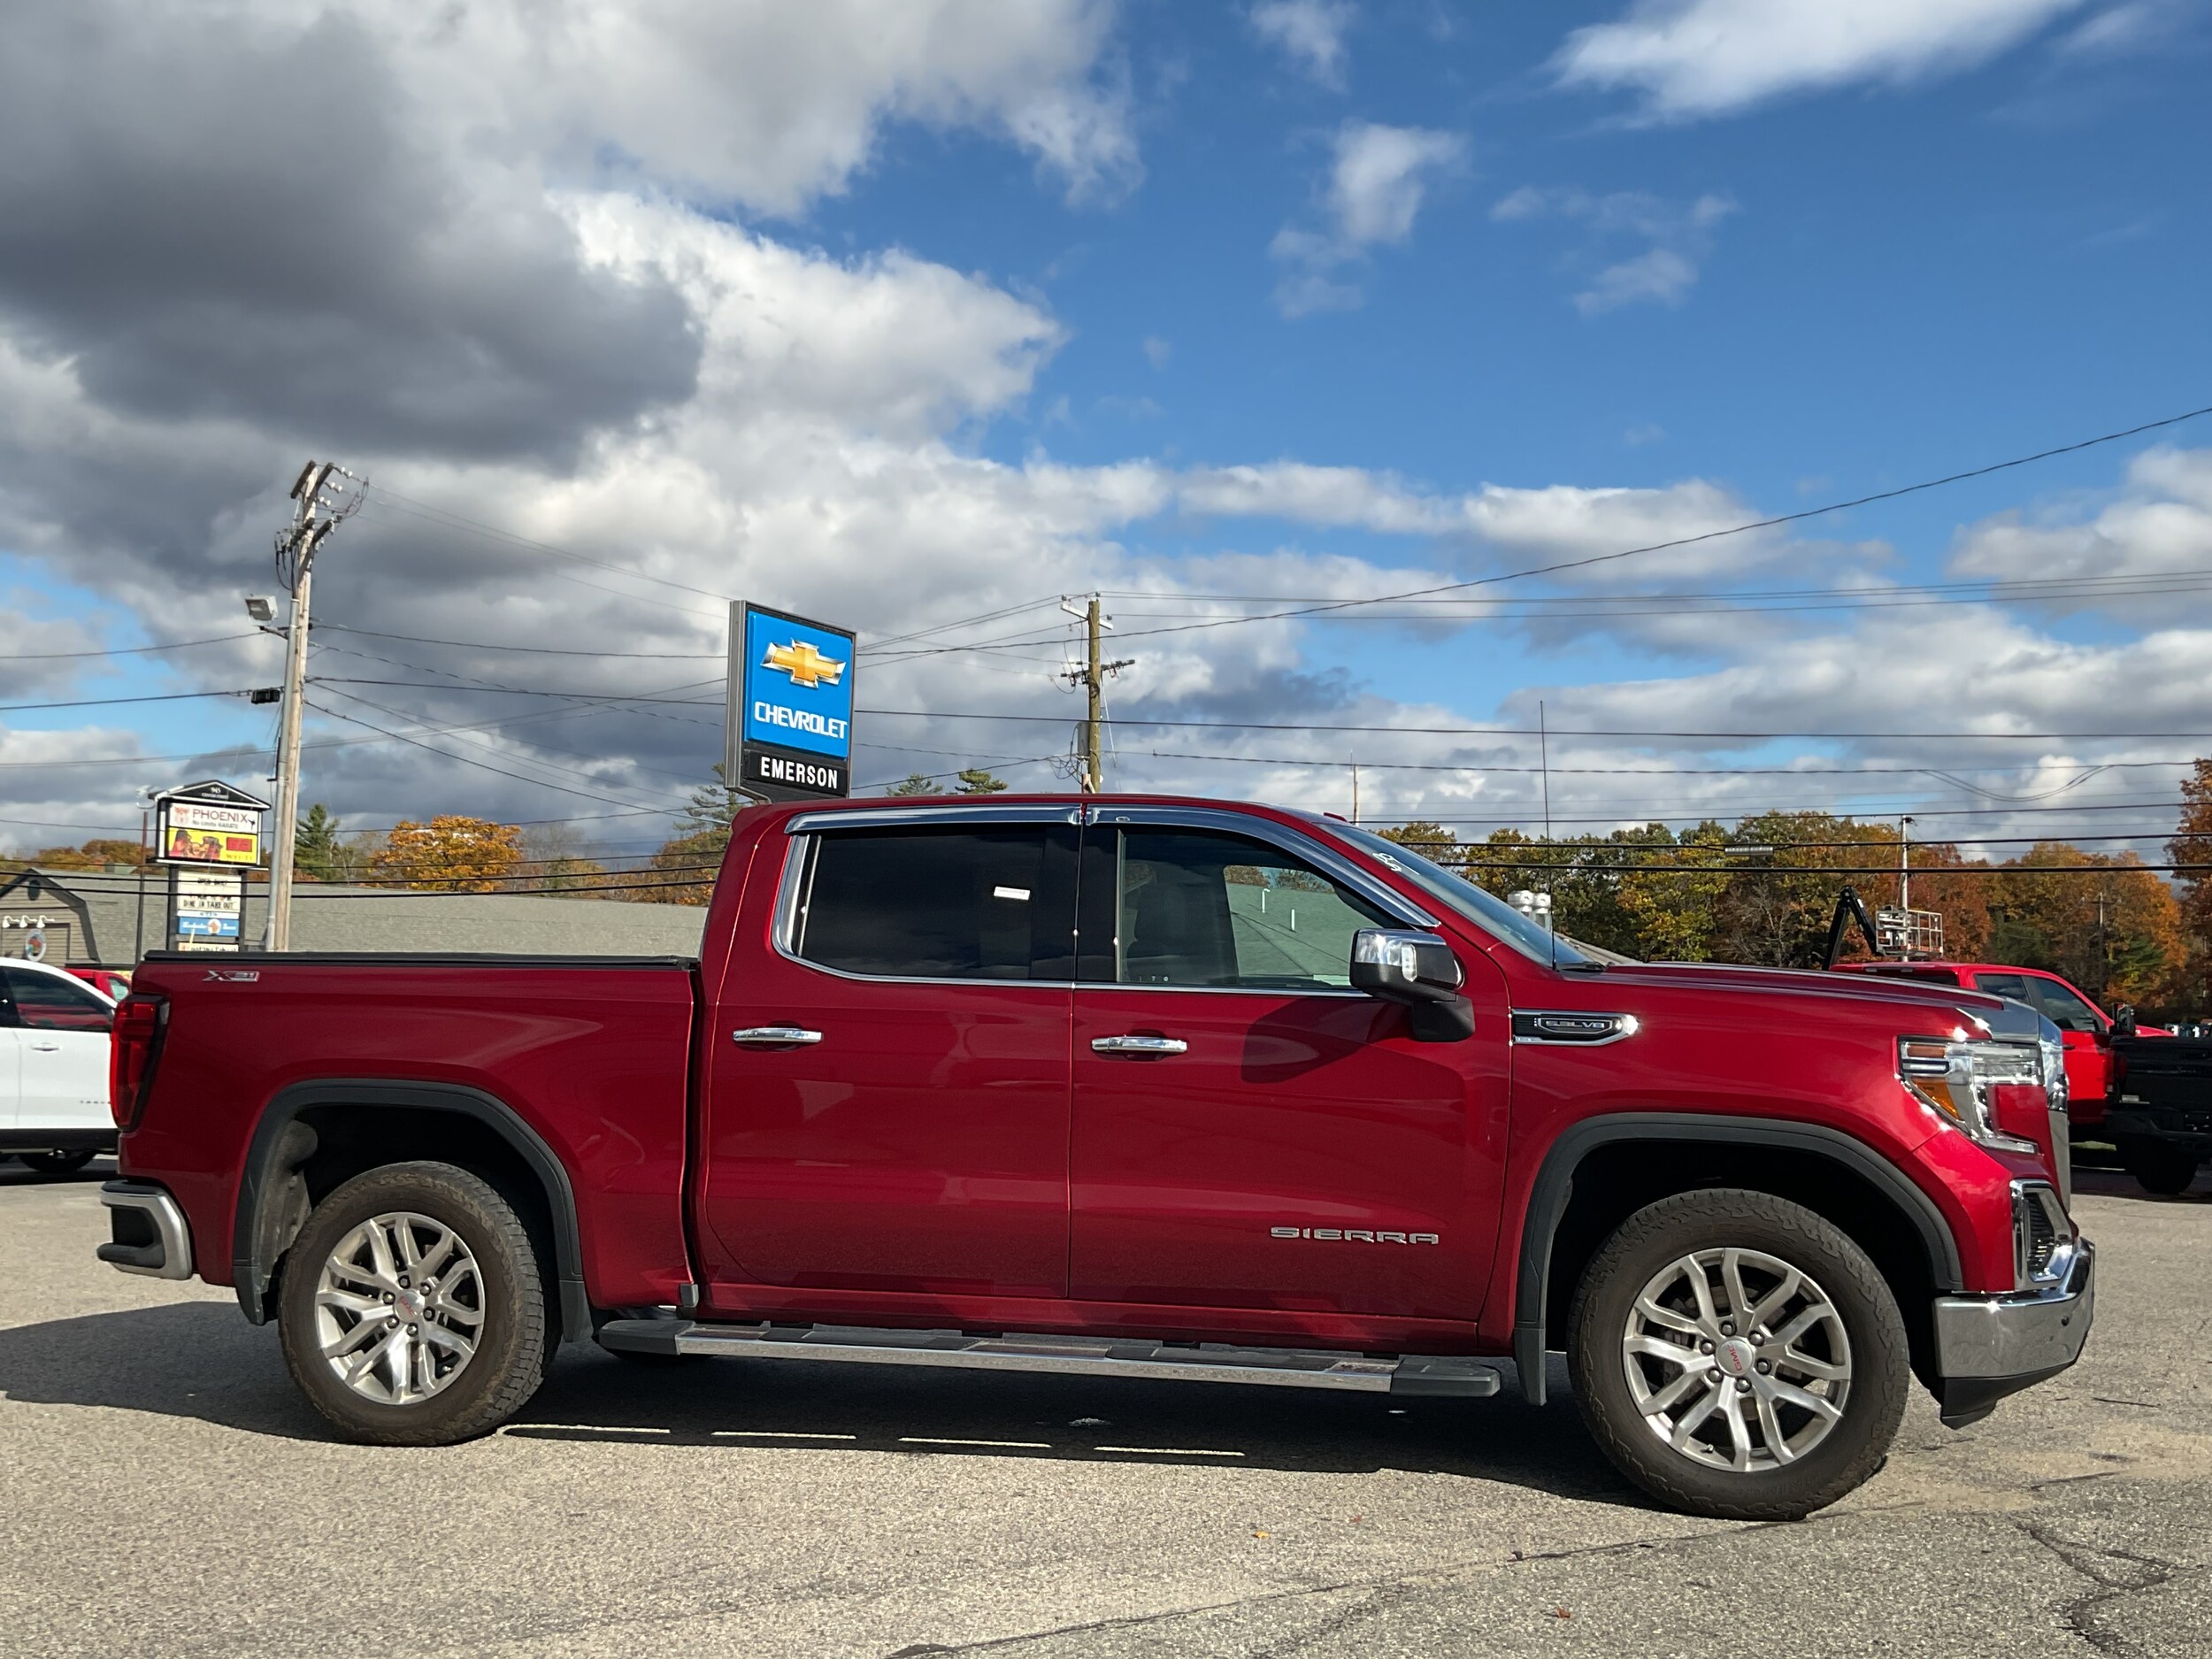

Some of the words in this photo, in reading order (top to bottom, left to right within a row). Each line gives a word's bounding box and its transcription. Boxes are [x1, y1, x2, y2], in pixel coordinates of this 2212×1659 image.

[754, 701, 848, 740] CHEVROLET
[760, 756, 838, 789] EMERSON
[192, 809, 248, 823] PHOENIX
[1271, 1226, 1439, 1245] SIERRA
[1727, 1344, 1742, 1371] GMC
